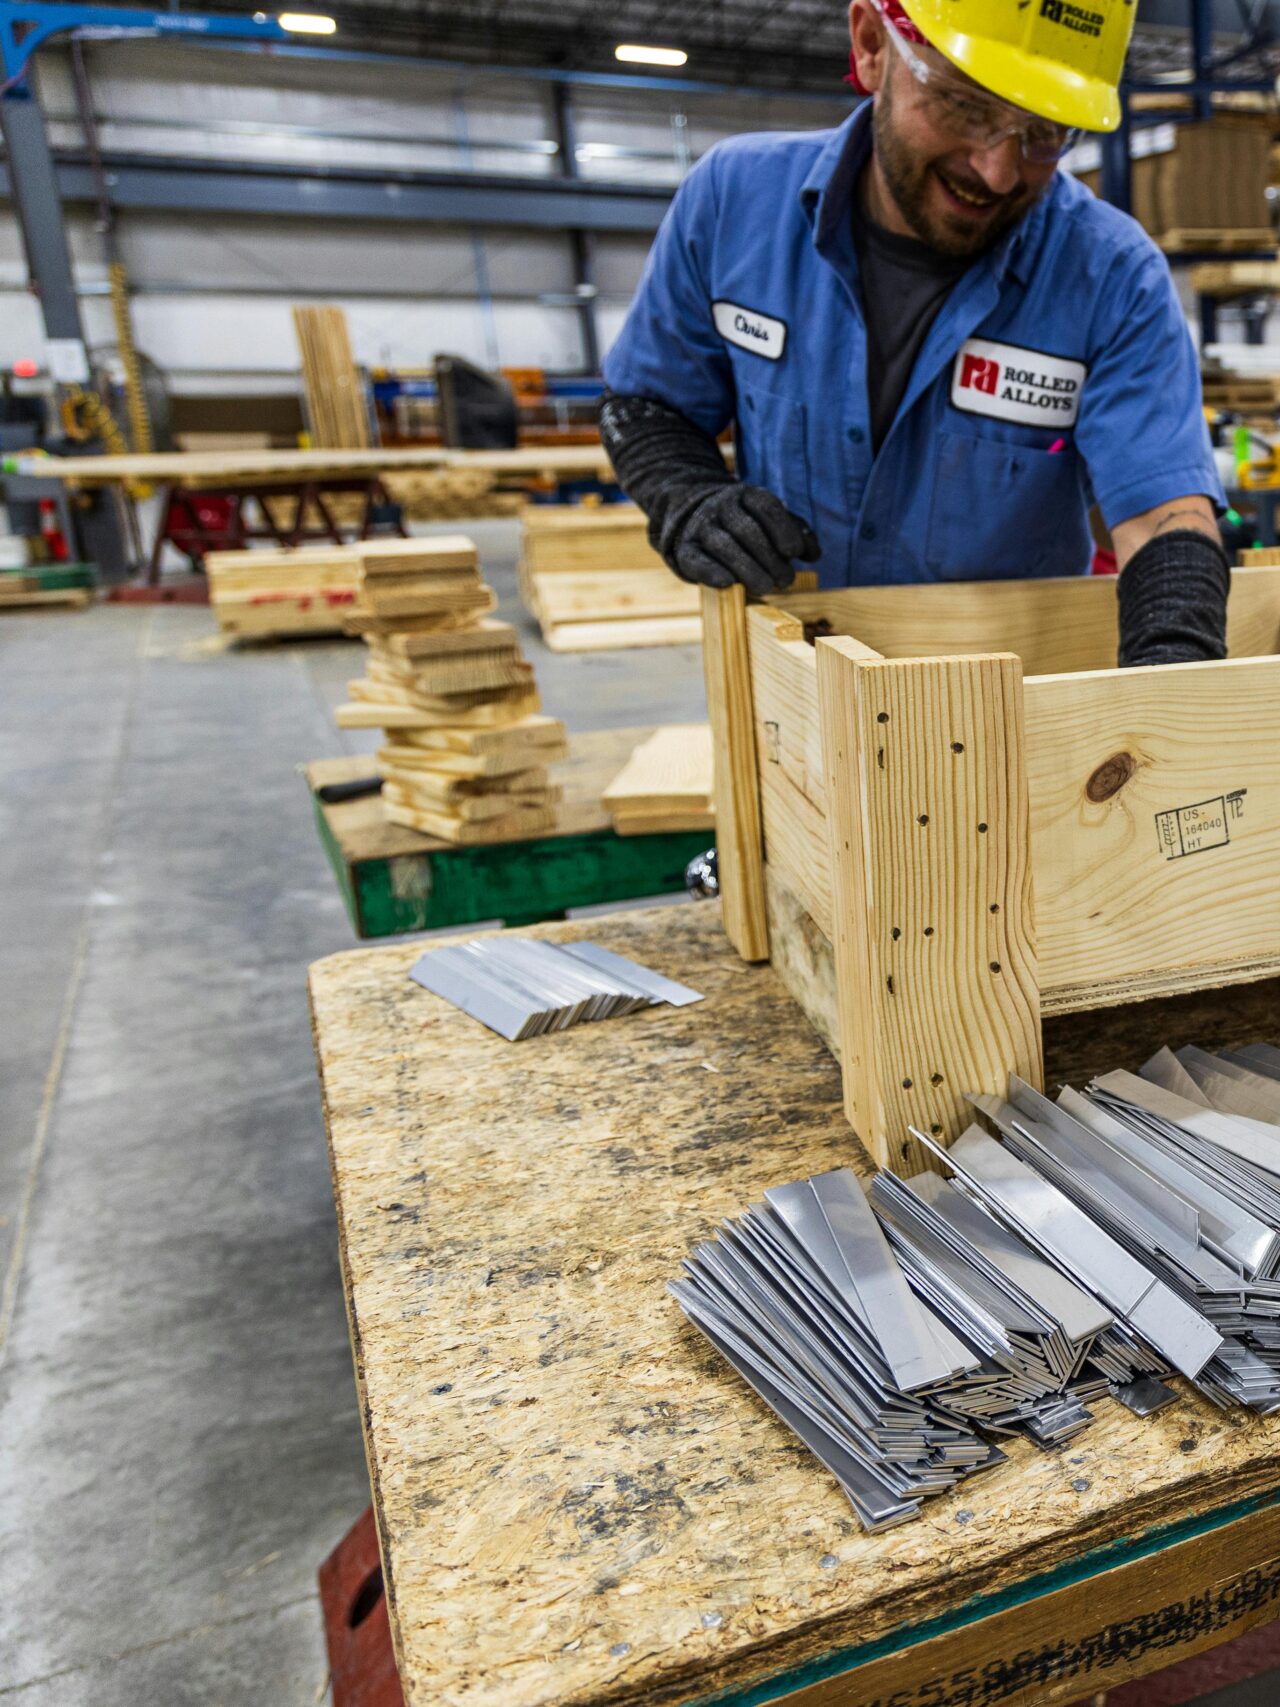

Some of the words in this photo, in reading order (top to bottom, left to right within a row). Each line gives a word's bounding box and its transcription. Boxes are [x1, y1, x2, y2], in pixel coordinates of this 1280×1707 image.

[1064, 3, 1104, 26] ROLLED
[1062, 15, 1101, 37] ALLOYS
[1004, 366, 1077, 393] ROLLED
[1001, 386, 1072, 410] ALLOYS
[1185, 817, 1222, 836] 164040
[1187, 836, 1202, 850] HT
